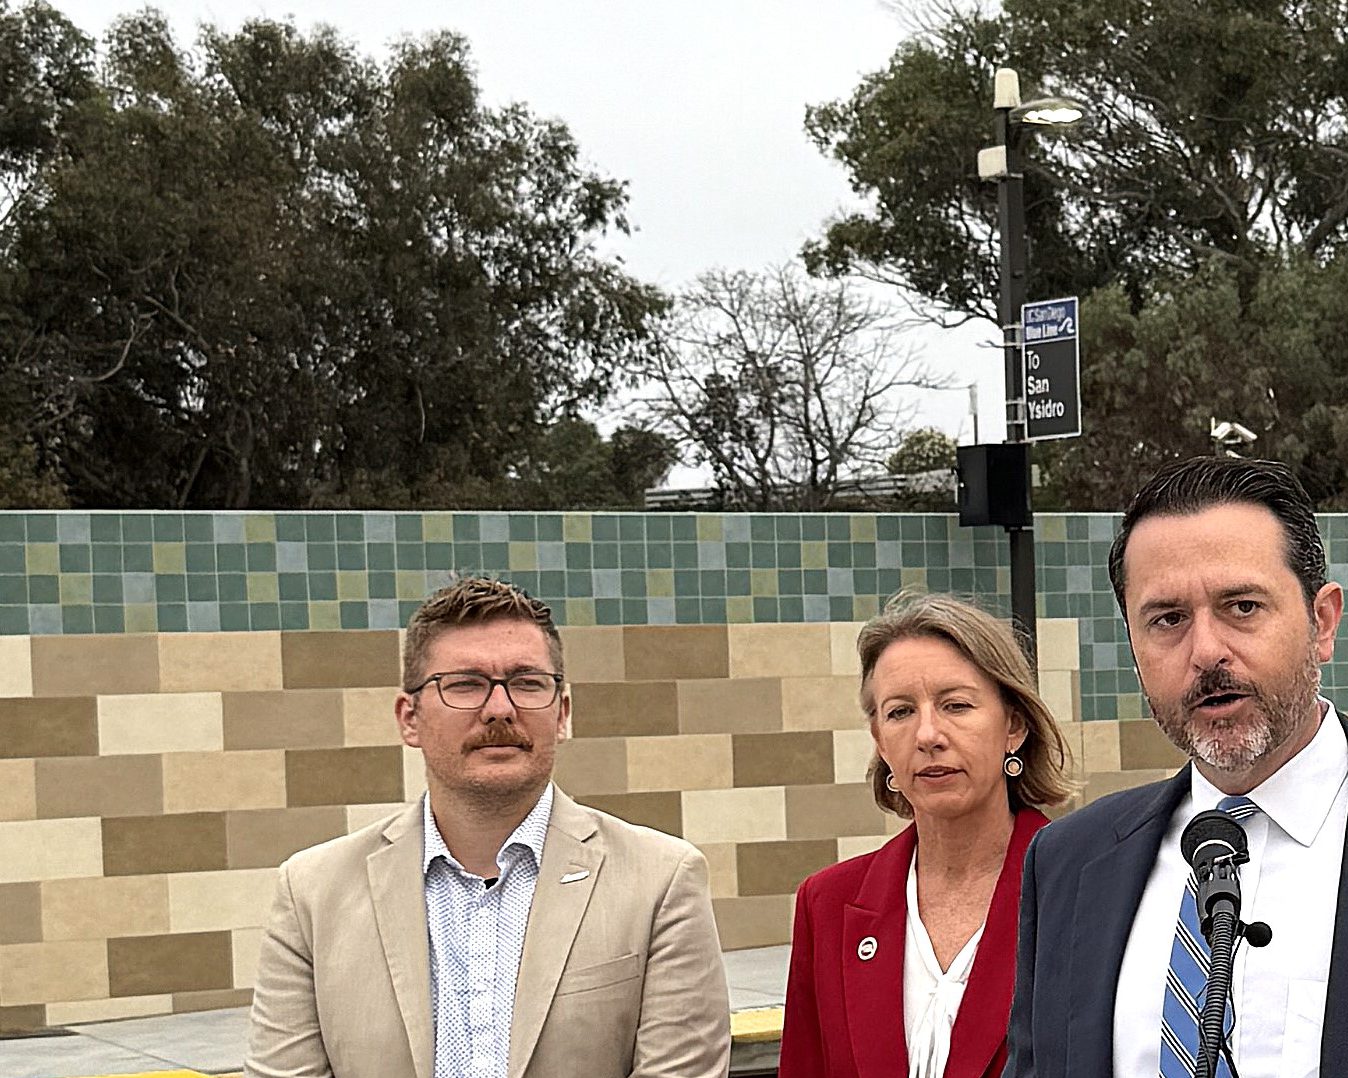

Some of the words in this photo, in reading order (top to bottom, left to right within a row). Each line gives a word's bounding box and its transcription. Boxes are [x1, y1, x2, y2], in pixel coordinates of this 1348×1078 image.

[1027, 350, 1040, 370] To
[1027, 376, 1050, 396] San
[1027, 399, 1065, 420] Ysidro
